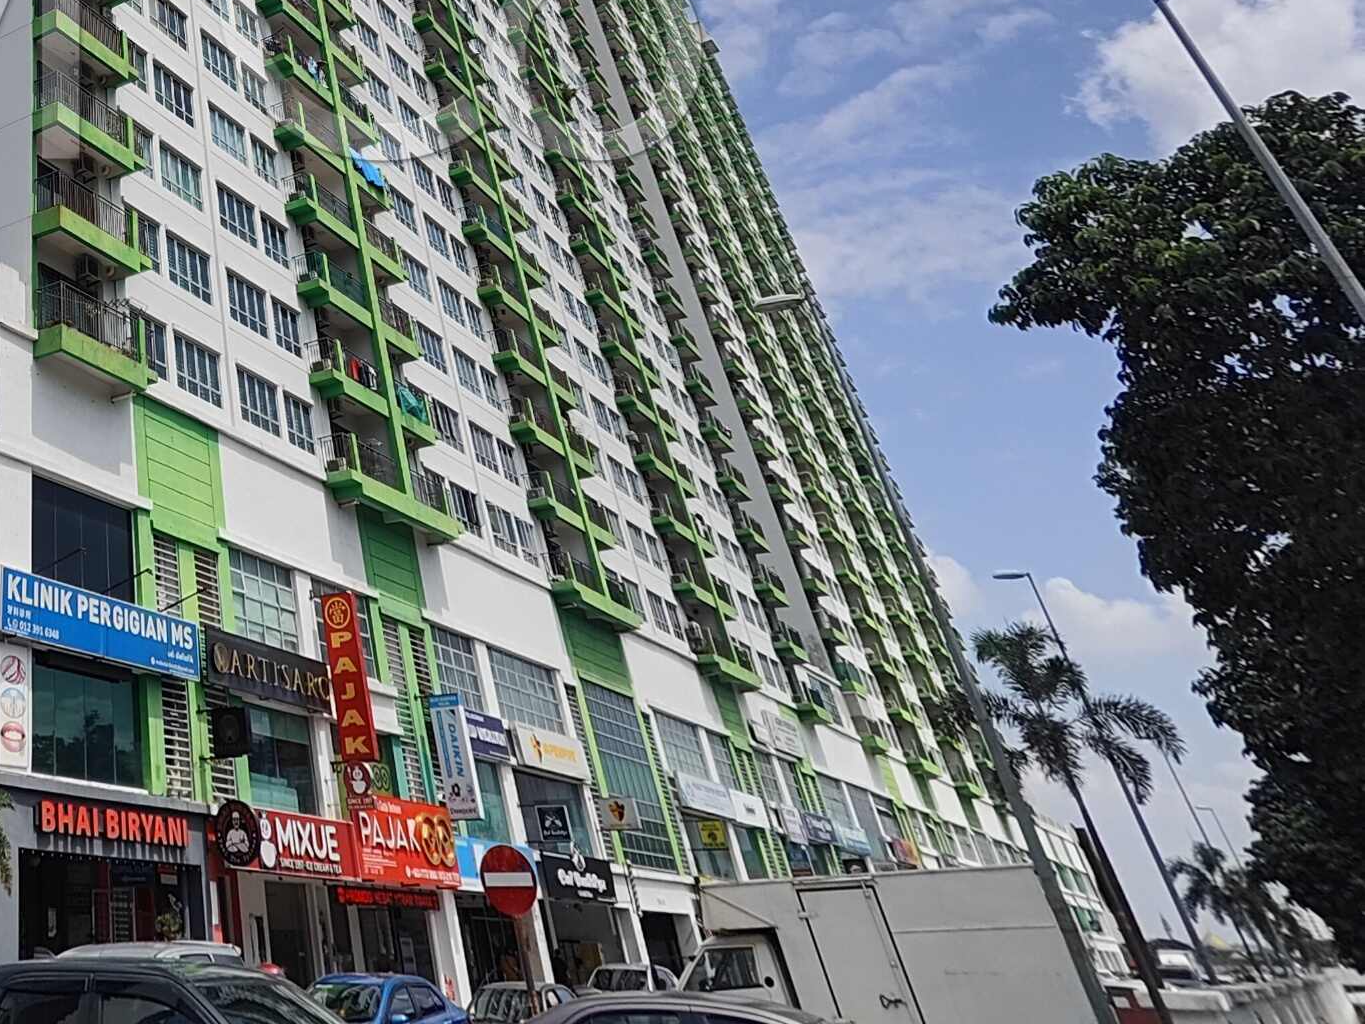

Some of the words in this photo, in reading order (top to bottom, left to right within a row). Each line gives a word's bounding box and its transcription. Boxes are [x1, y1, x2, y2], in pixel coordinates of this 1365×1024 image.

[7, 573, 74, 617] KLINIK
[77, 593, 168, 644] PERGIGIAN
[171, 622, 194, 650] MS
[330, 631, 370, 754] PAJAK
[41, 799, 99, 837] BHAI
[106, 808, 189, 847] BIRYANI
[275, 816, 341, 862] MIXUE
